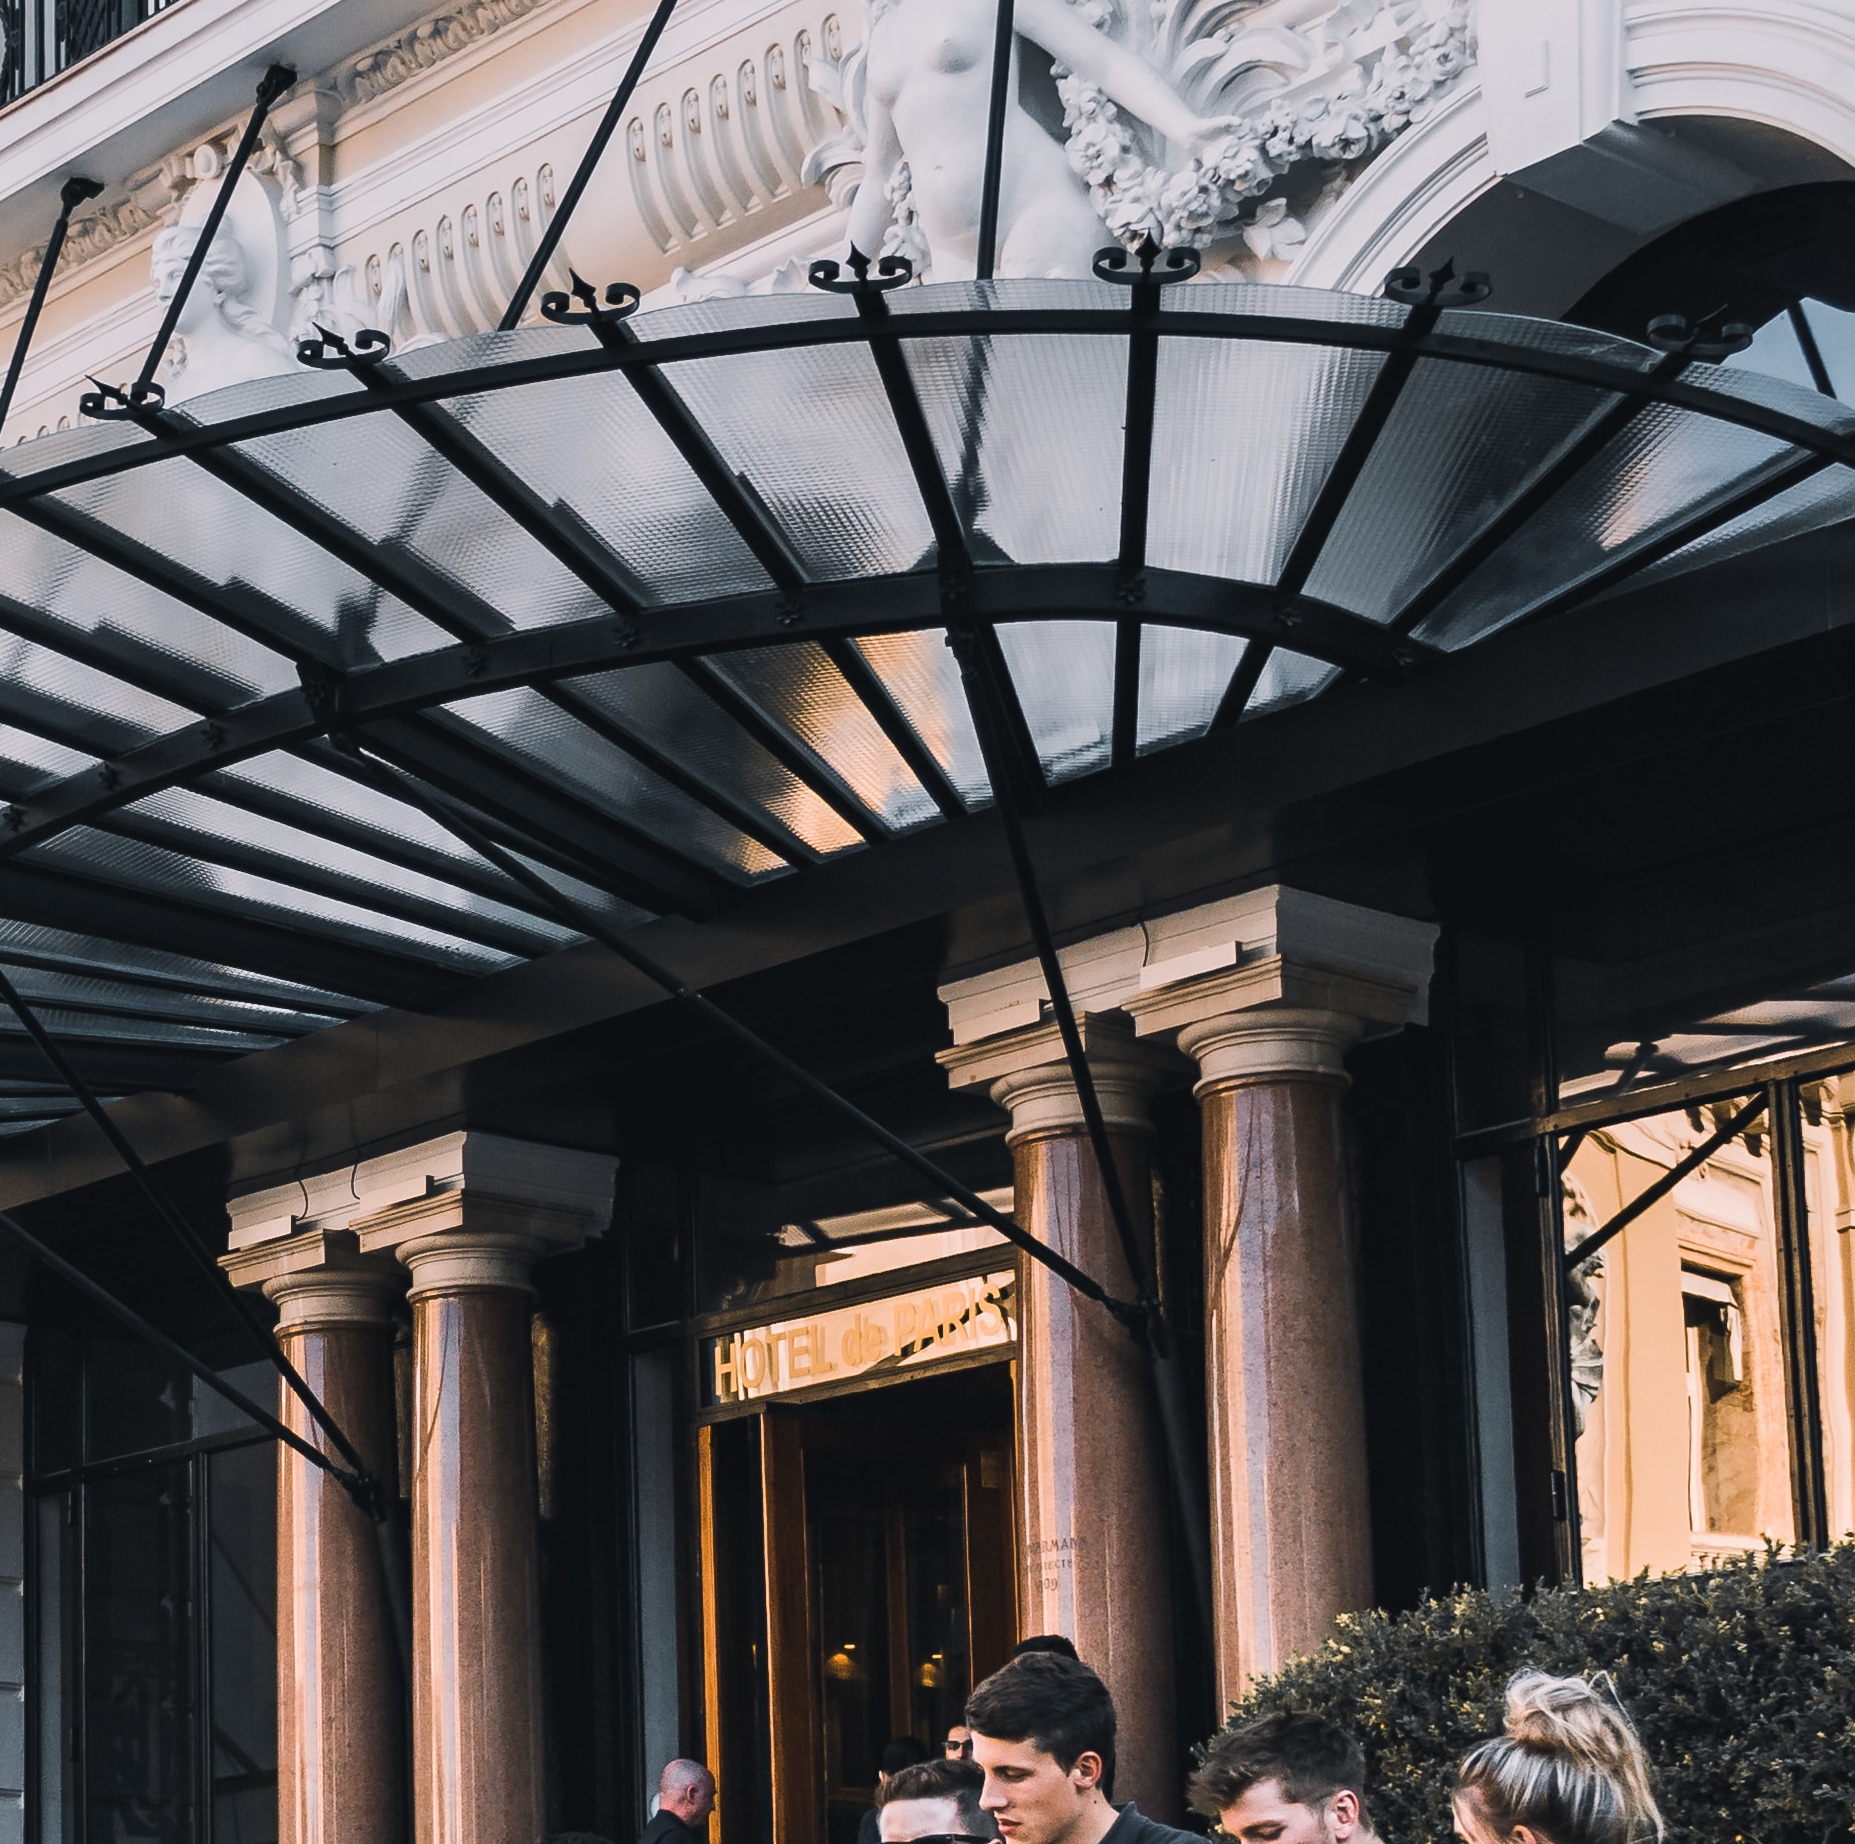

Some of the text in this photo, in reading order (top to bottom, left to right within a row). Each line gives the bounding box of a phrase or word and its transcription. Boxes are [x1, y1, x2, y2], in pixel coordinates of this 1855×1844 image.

[715, 1283, 1003, 1396] HOTEL de PARIS
